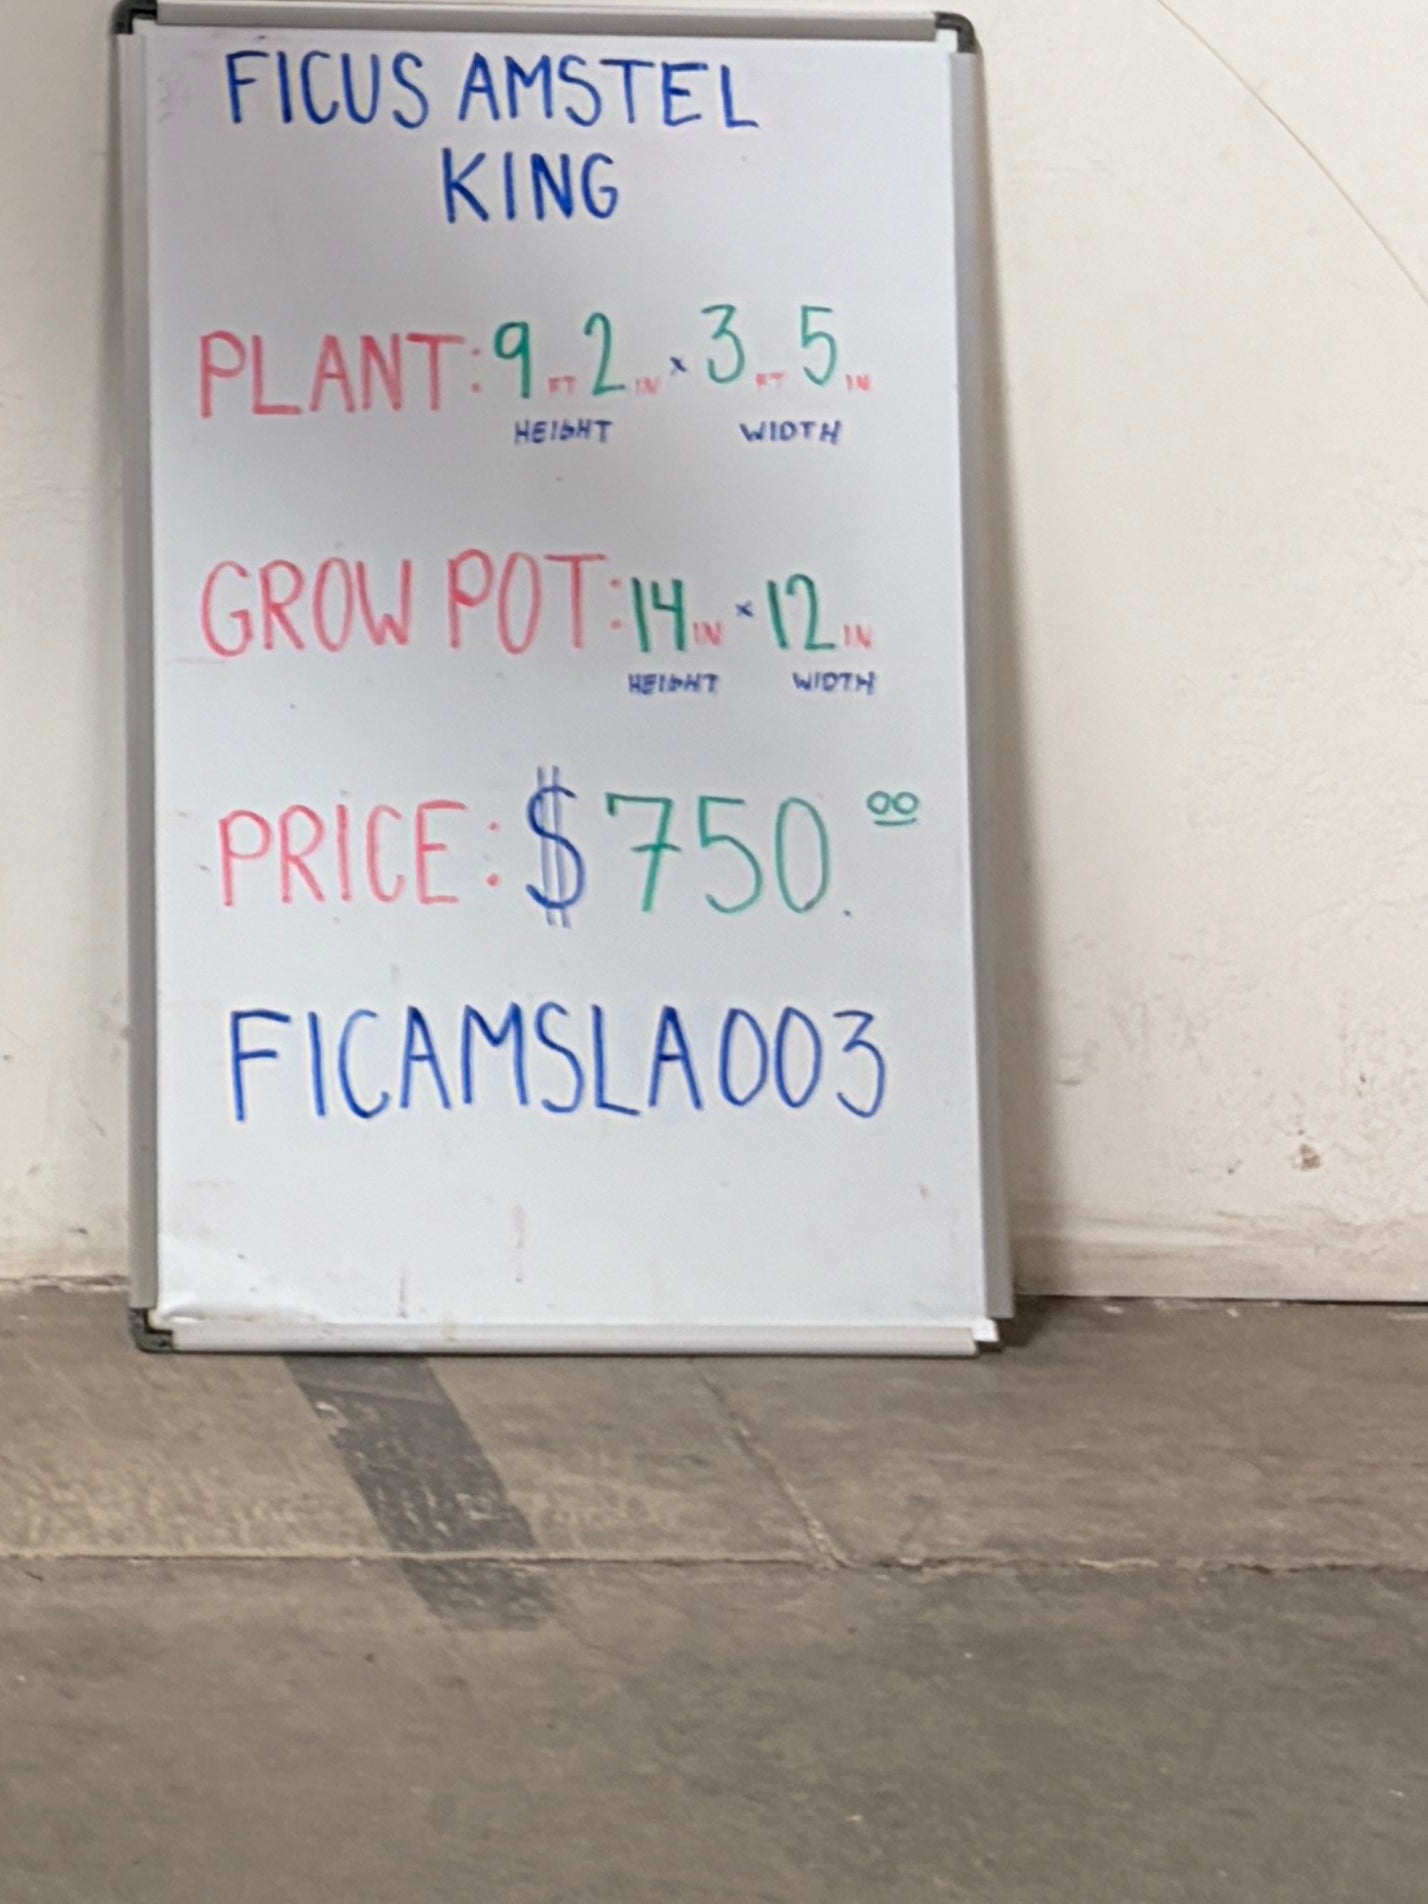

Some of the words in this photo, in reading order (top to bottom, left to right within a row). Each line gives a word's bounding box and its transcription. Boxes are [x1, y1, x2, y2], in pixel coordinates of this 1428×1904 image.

[224, 50, 431, 130] FICUS
[456, 54, 760, 130] AMSTEL
[441, 147, 621, 224] KING
[198, 329, 483, 419] PLANT:
[492, 319, 532, 399] 9
[583, 311, 626, 397] 2
[701, 303, 746, 385] 3
[799, 304, 838, 387] 5
[513, 418, 613, 445] HEIGHT
[740, 419, 843, 446] WIDTH
[200, 558, 415, 659] GROW
[446, 547, 622, 658] POT:
[627, 672, 721, 696] HEIGHT
[791, 671, 877, 696] WIDTH
[217, 799, 502, 909] PRICE:
[229, 1001, 888, 1123] FICAMSLA003
